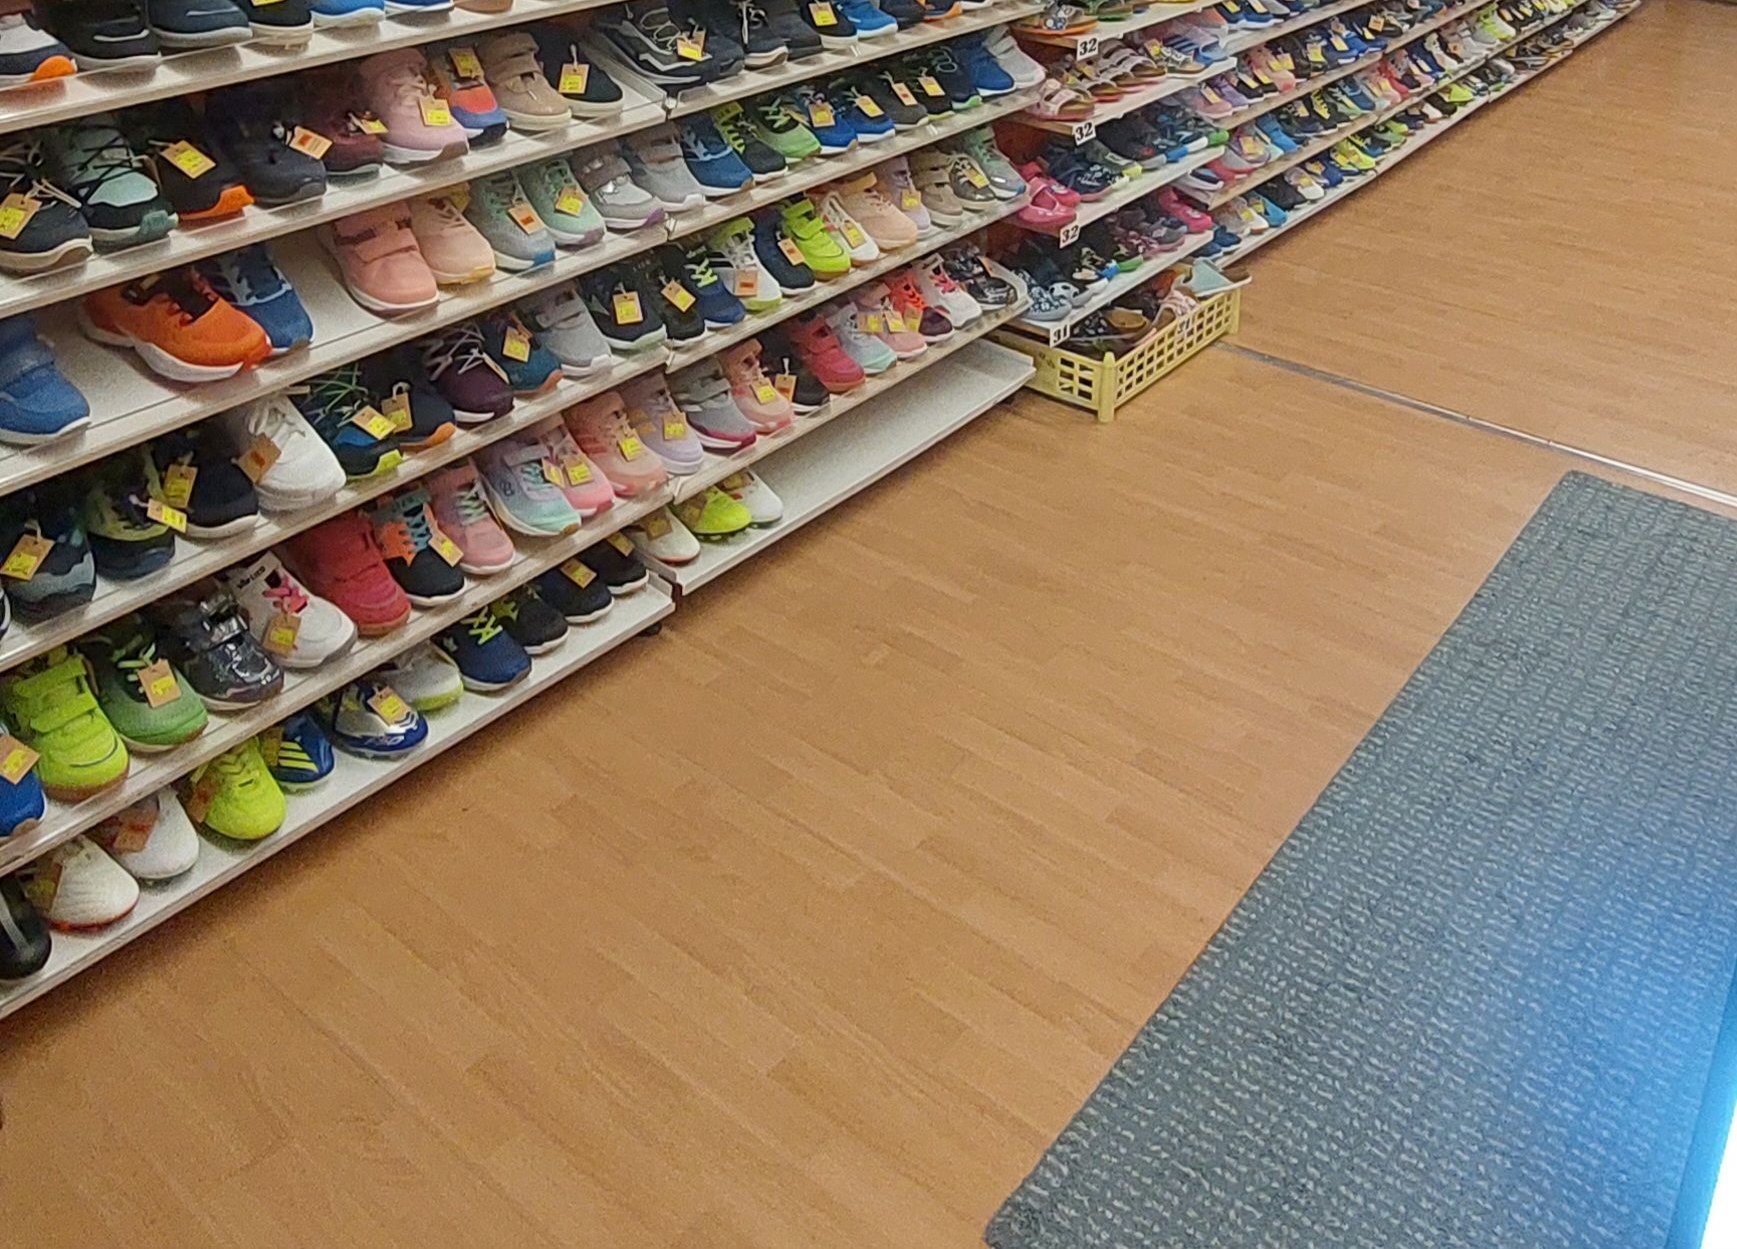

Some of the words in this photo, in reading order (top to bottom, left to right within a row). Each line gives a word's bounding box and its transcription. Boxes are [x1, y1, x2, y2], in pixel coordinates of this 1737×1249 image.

[1079, 38, 1097, 56] 32
[1075, 121, 1093, 141] 32
[1061, 224, 1080, 244] 32
[1053, 324, 1068, 344] 31
